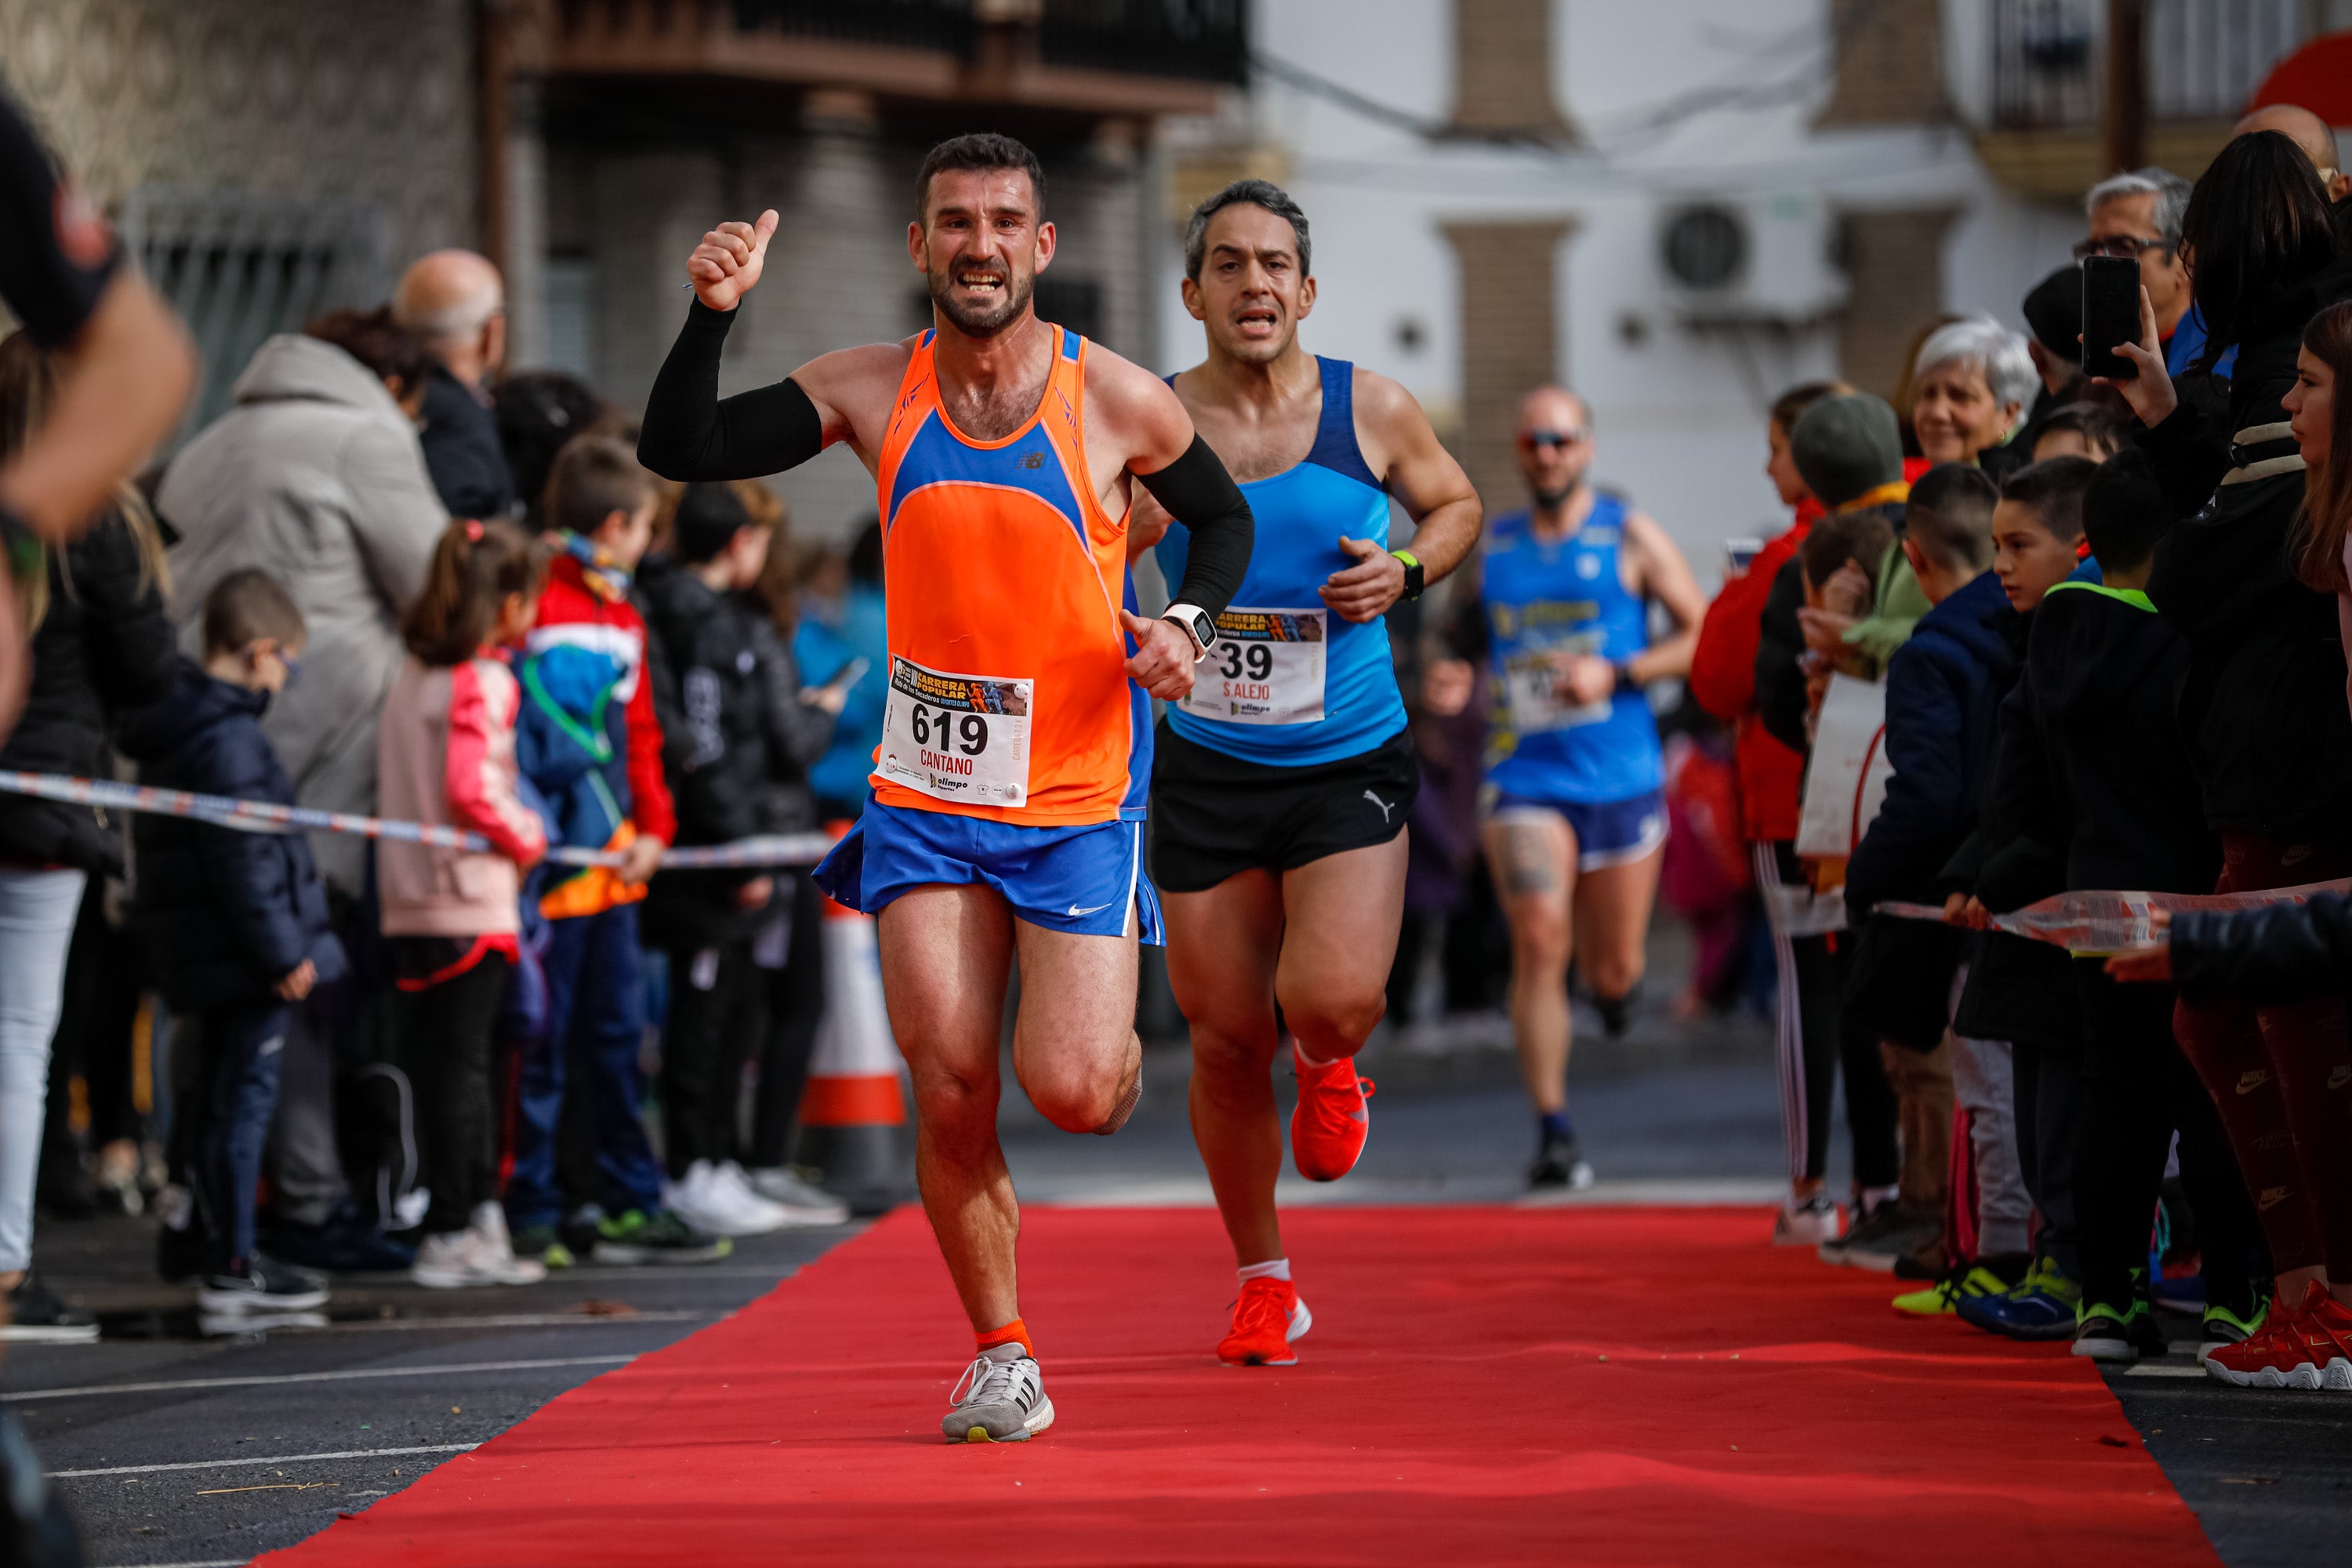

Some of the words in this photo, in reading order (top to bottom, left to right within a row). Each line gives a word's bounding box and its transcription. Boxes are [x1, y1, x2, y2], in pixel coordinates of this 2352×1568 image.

[1219, 612, 1266, 624] ARRERA
[1220, 641, 1273, 681] 39
[917, 672, 967, 691] CARRERA
[915, 688, 940, 703] Secaderos
[916, 682, 966, 699] POPULAR
[940, 697, 956, 707] DEPORTES
[913, 703, 989, 755] 619
[1012, 735, 1022, 760] CARRERA
[920, 749, 973, 775] CANTANO
[938, 777, 968, 789] olimpo
[2241, 1069, 2267, 1084] NIKE
[2261, 1185, 2287, 1201] NIKE
